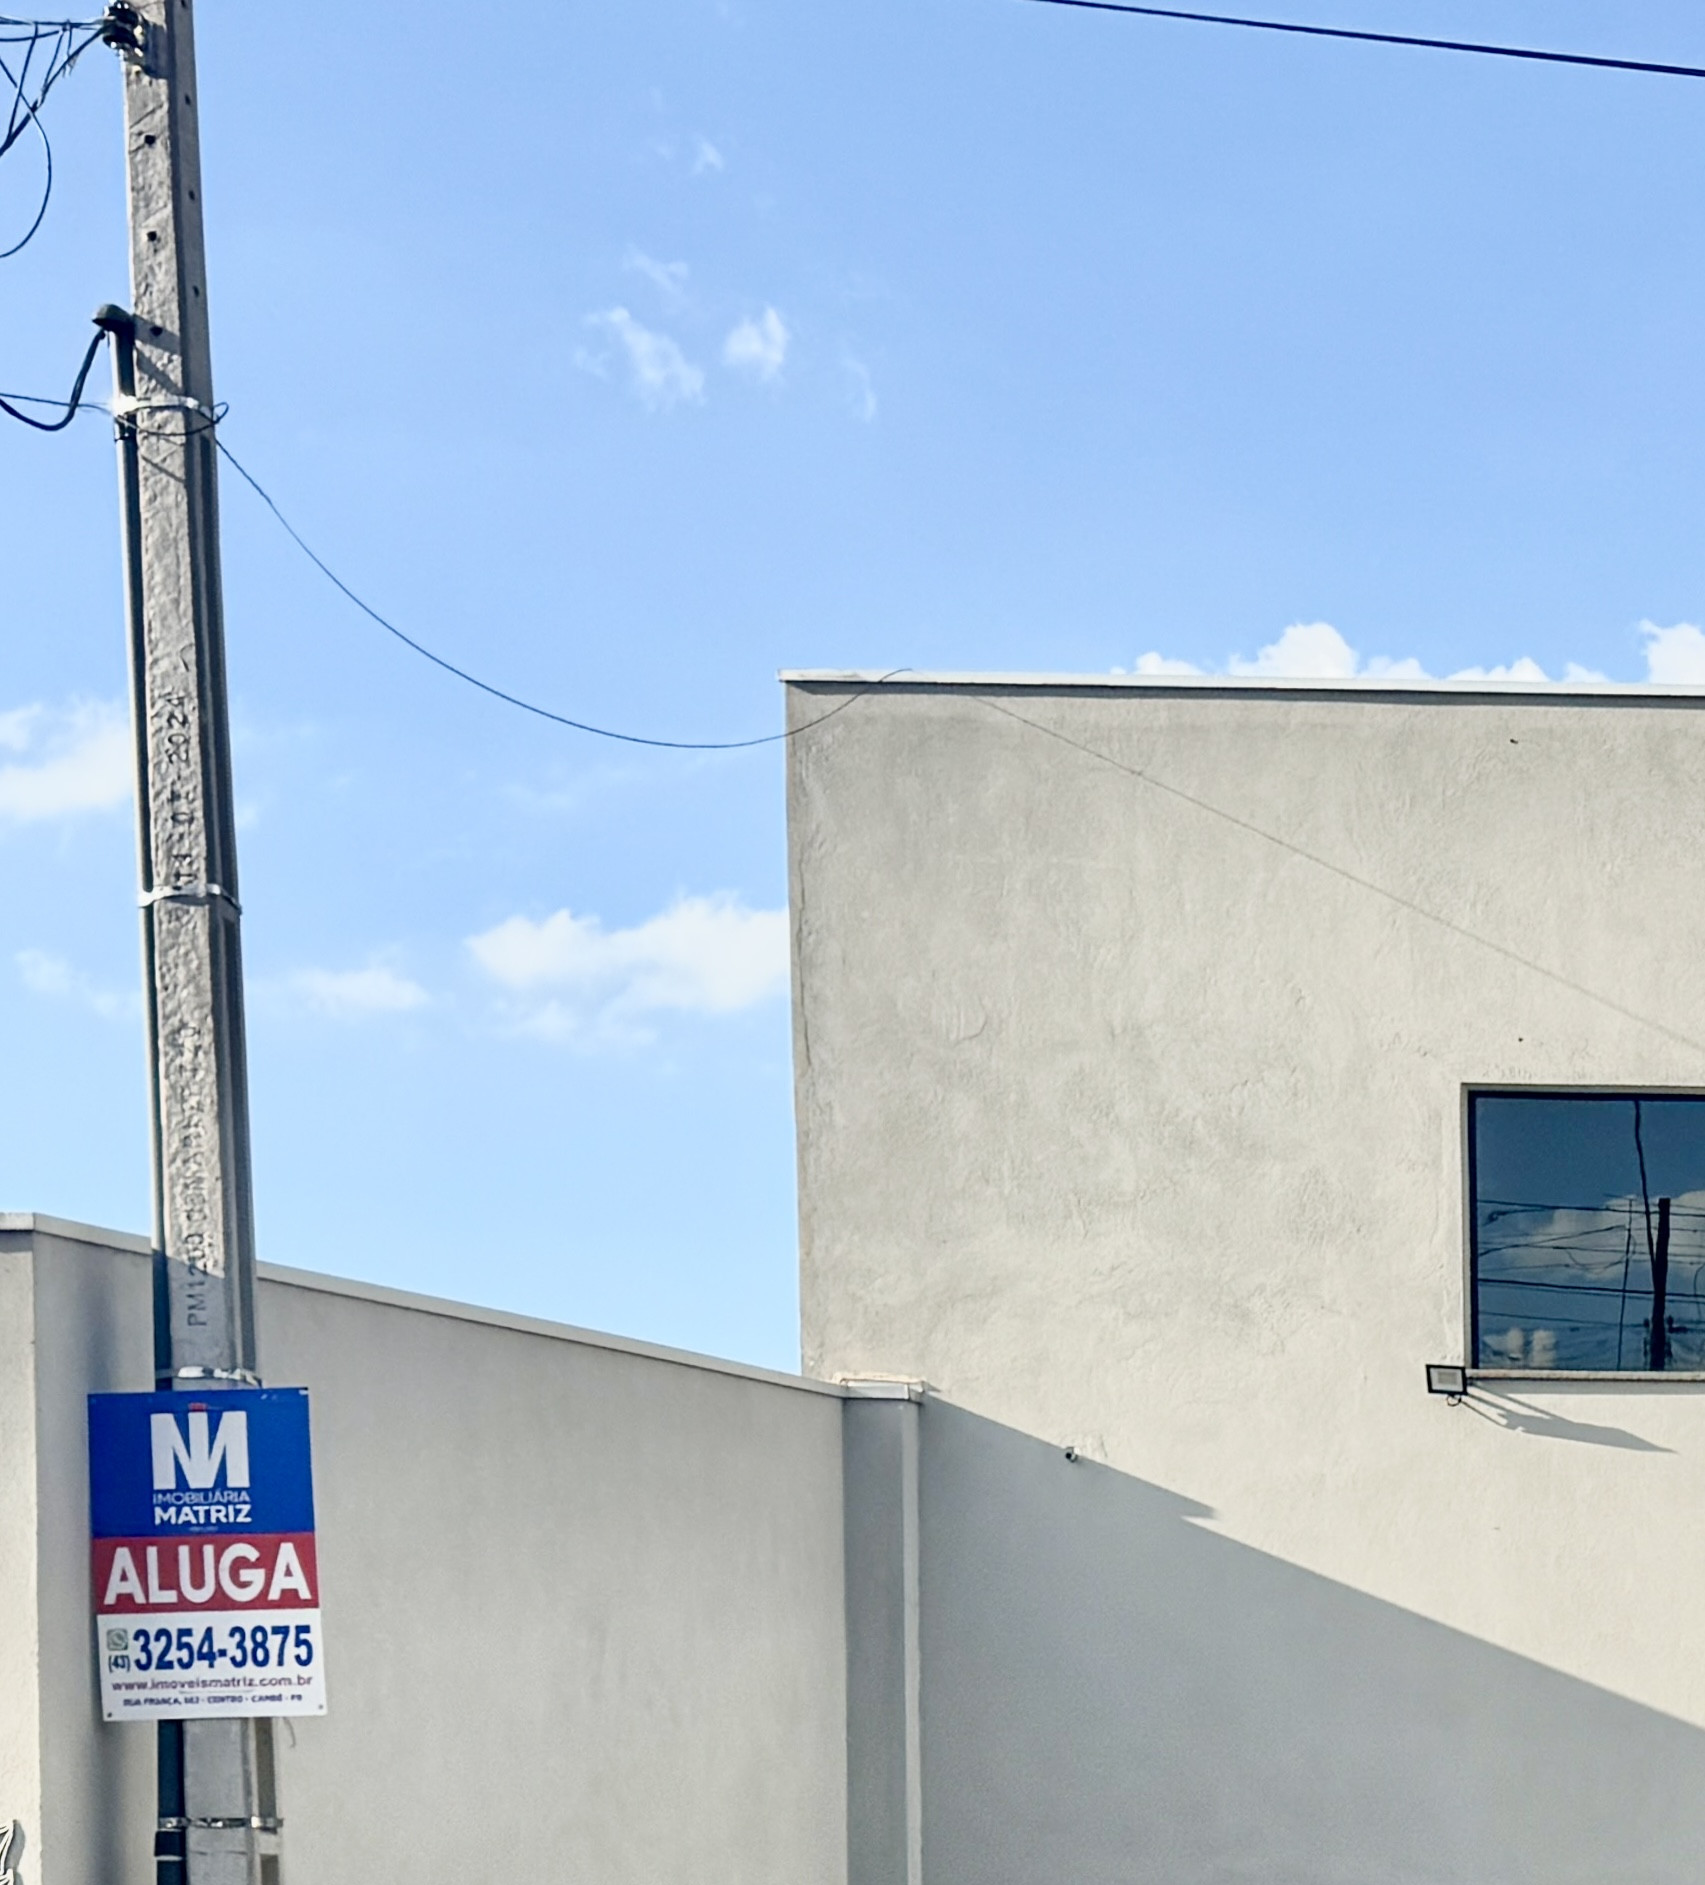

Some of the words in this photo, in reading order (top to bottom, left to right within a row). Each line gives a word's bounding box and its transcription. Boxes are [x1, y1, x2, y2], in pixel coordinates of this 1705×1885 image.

[154, 1504, 252, 1526] MATRIZ
[104, 1542, 313, 1606] ALUGA
[133, 1624, 314, 1672] 3254-3875
[111, 1674, 313, 1692] www.imoveismatriz.com.br
